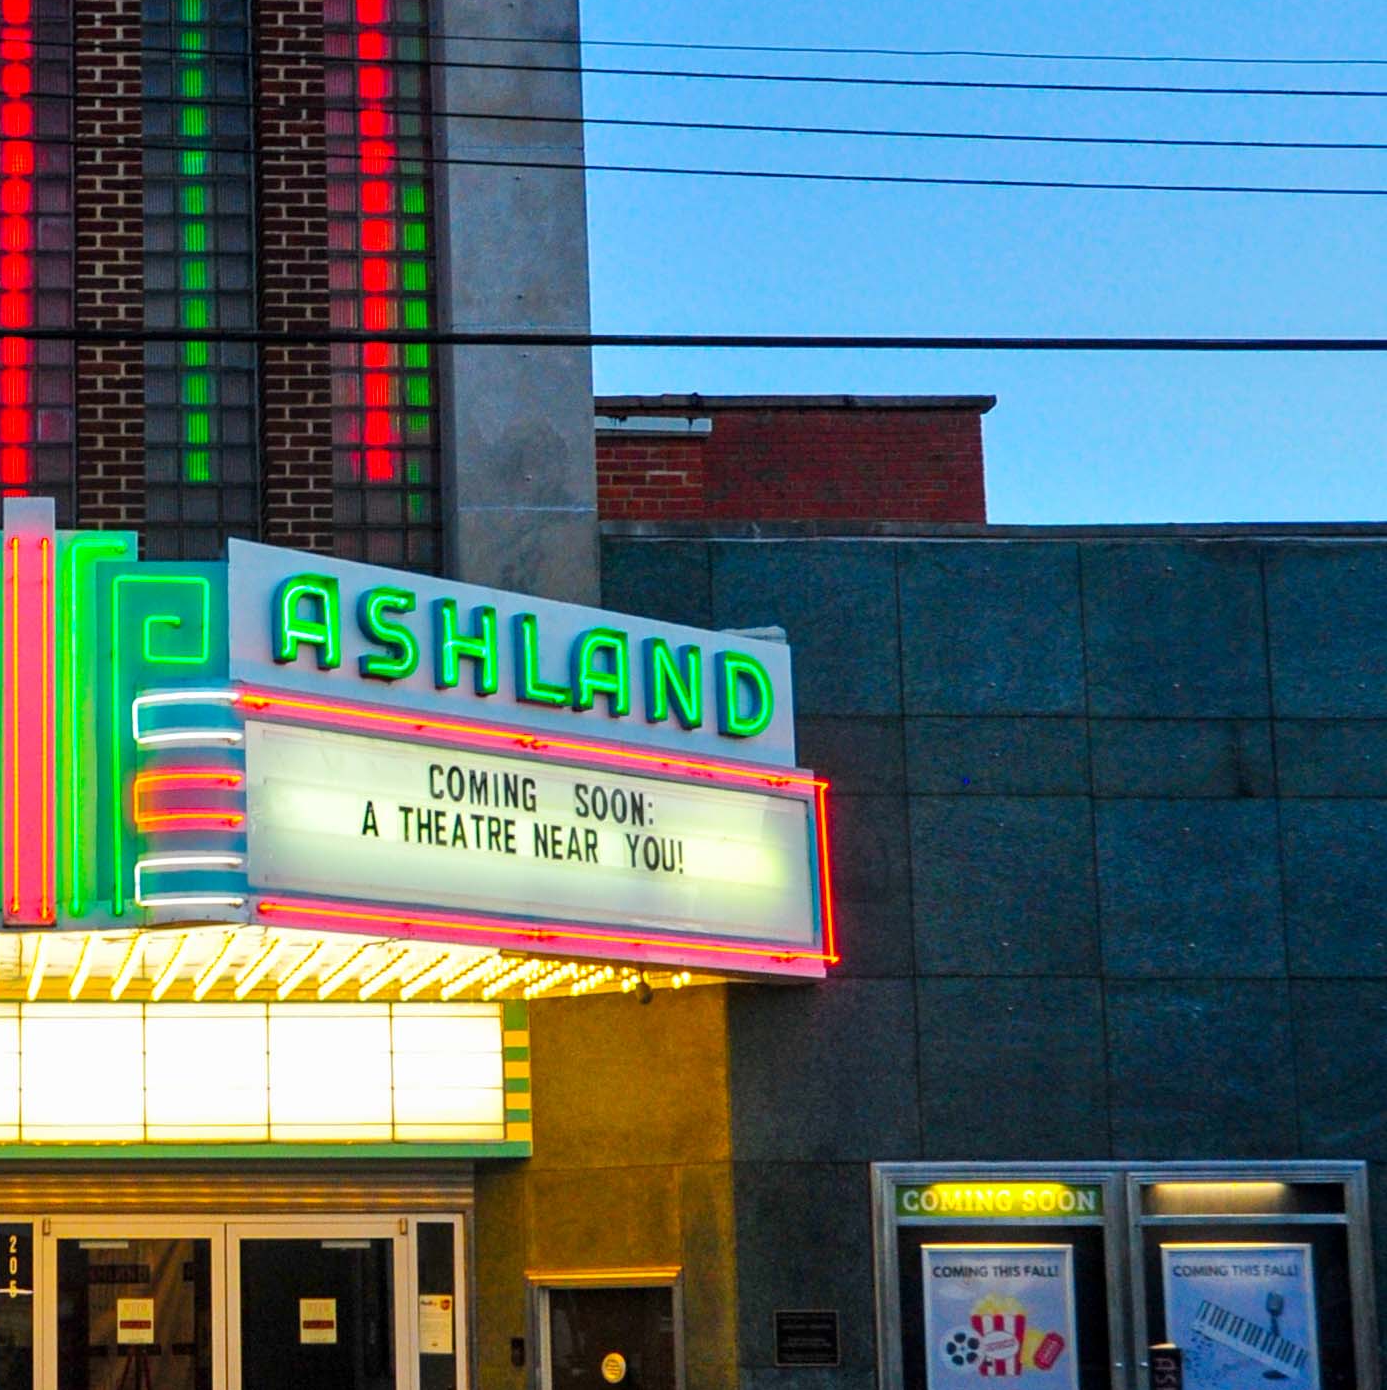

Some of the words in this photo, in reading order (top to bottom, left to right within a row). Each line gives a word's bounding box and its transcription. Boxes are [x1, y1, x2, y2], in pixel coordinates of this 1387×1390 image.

[272, 573, 775, 738] ASHLAND
[428, 763, 537, 812] COMING
[362, 800, 379, 837] A
[398, 806, 517, 854] THEATRE
[534, 823, 599, 864] NEAR
[626, 833, 684, 874] YOU!
[902, 1189, 1011, 1212] COMING
[1021, 1189, 1096, 1212] SOON
[9, 1234, 18, 1299] 205
[932, 1265, 989, 1278] COMING
[993, 1265, 1021, 1278] THIS
[1024, 1265, 1059, 1278] FALL!
[1172, 1265, 1229, 1277] COMING
[1233, 1265, 1261, 1277] THIS
[1264, 1265, 1298, 1277] FALL!
